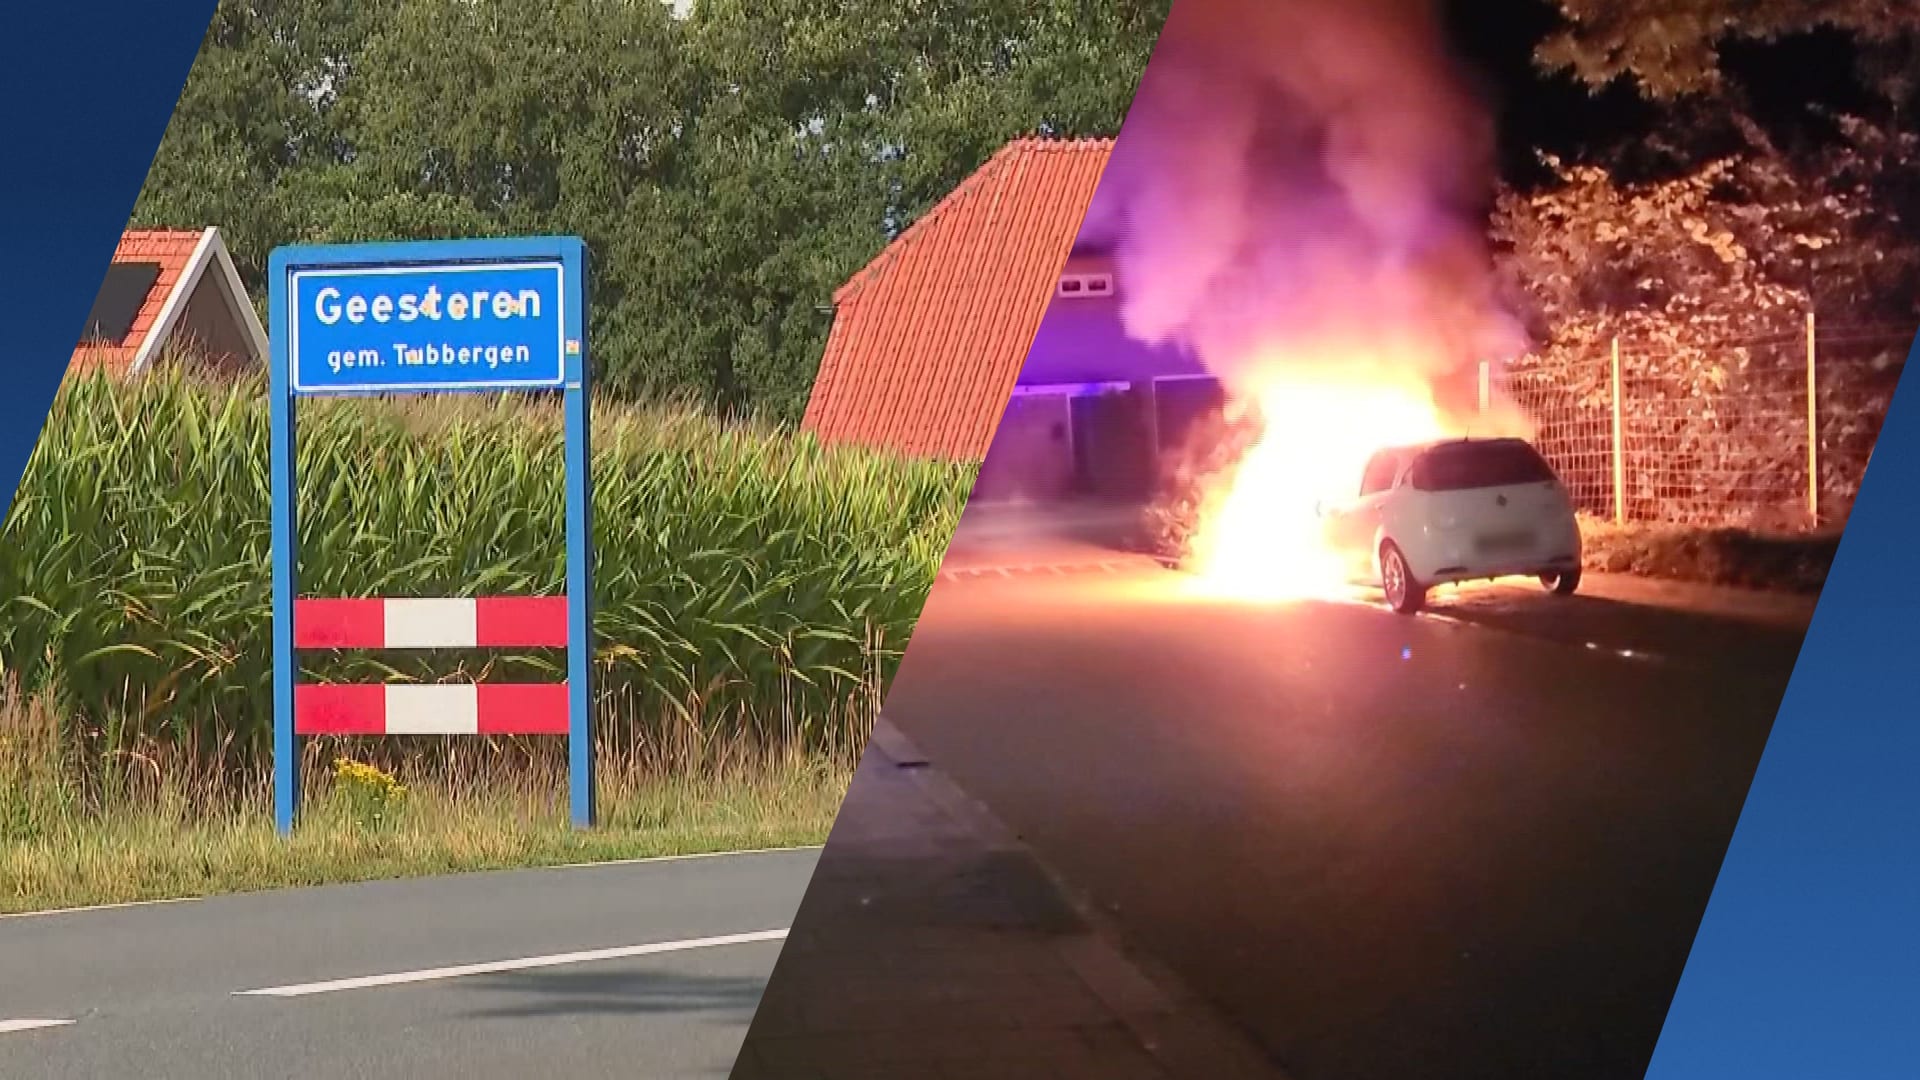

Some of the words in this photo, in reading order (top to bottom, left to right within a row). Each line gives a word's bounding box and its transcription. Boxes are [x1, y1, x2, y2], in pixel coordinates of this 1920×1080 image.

[315, 285, 541, 324] Geesteren
[327, 348, 384, 374] gem.
[393, 343, 530, 369] Tubbergen
